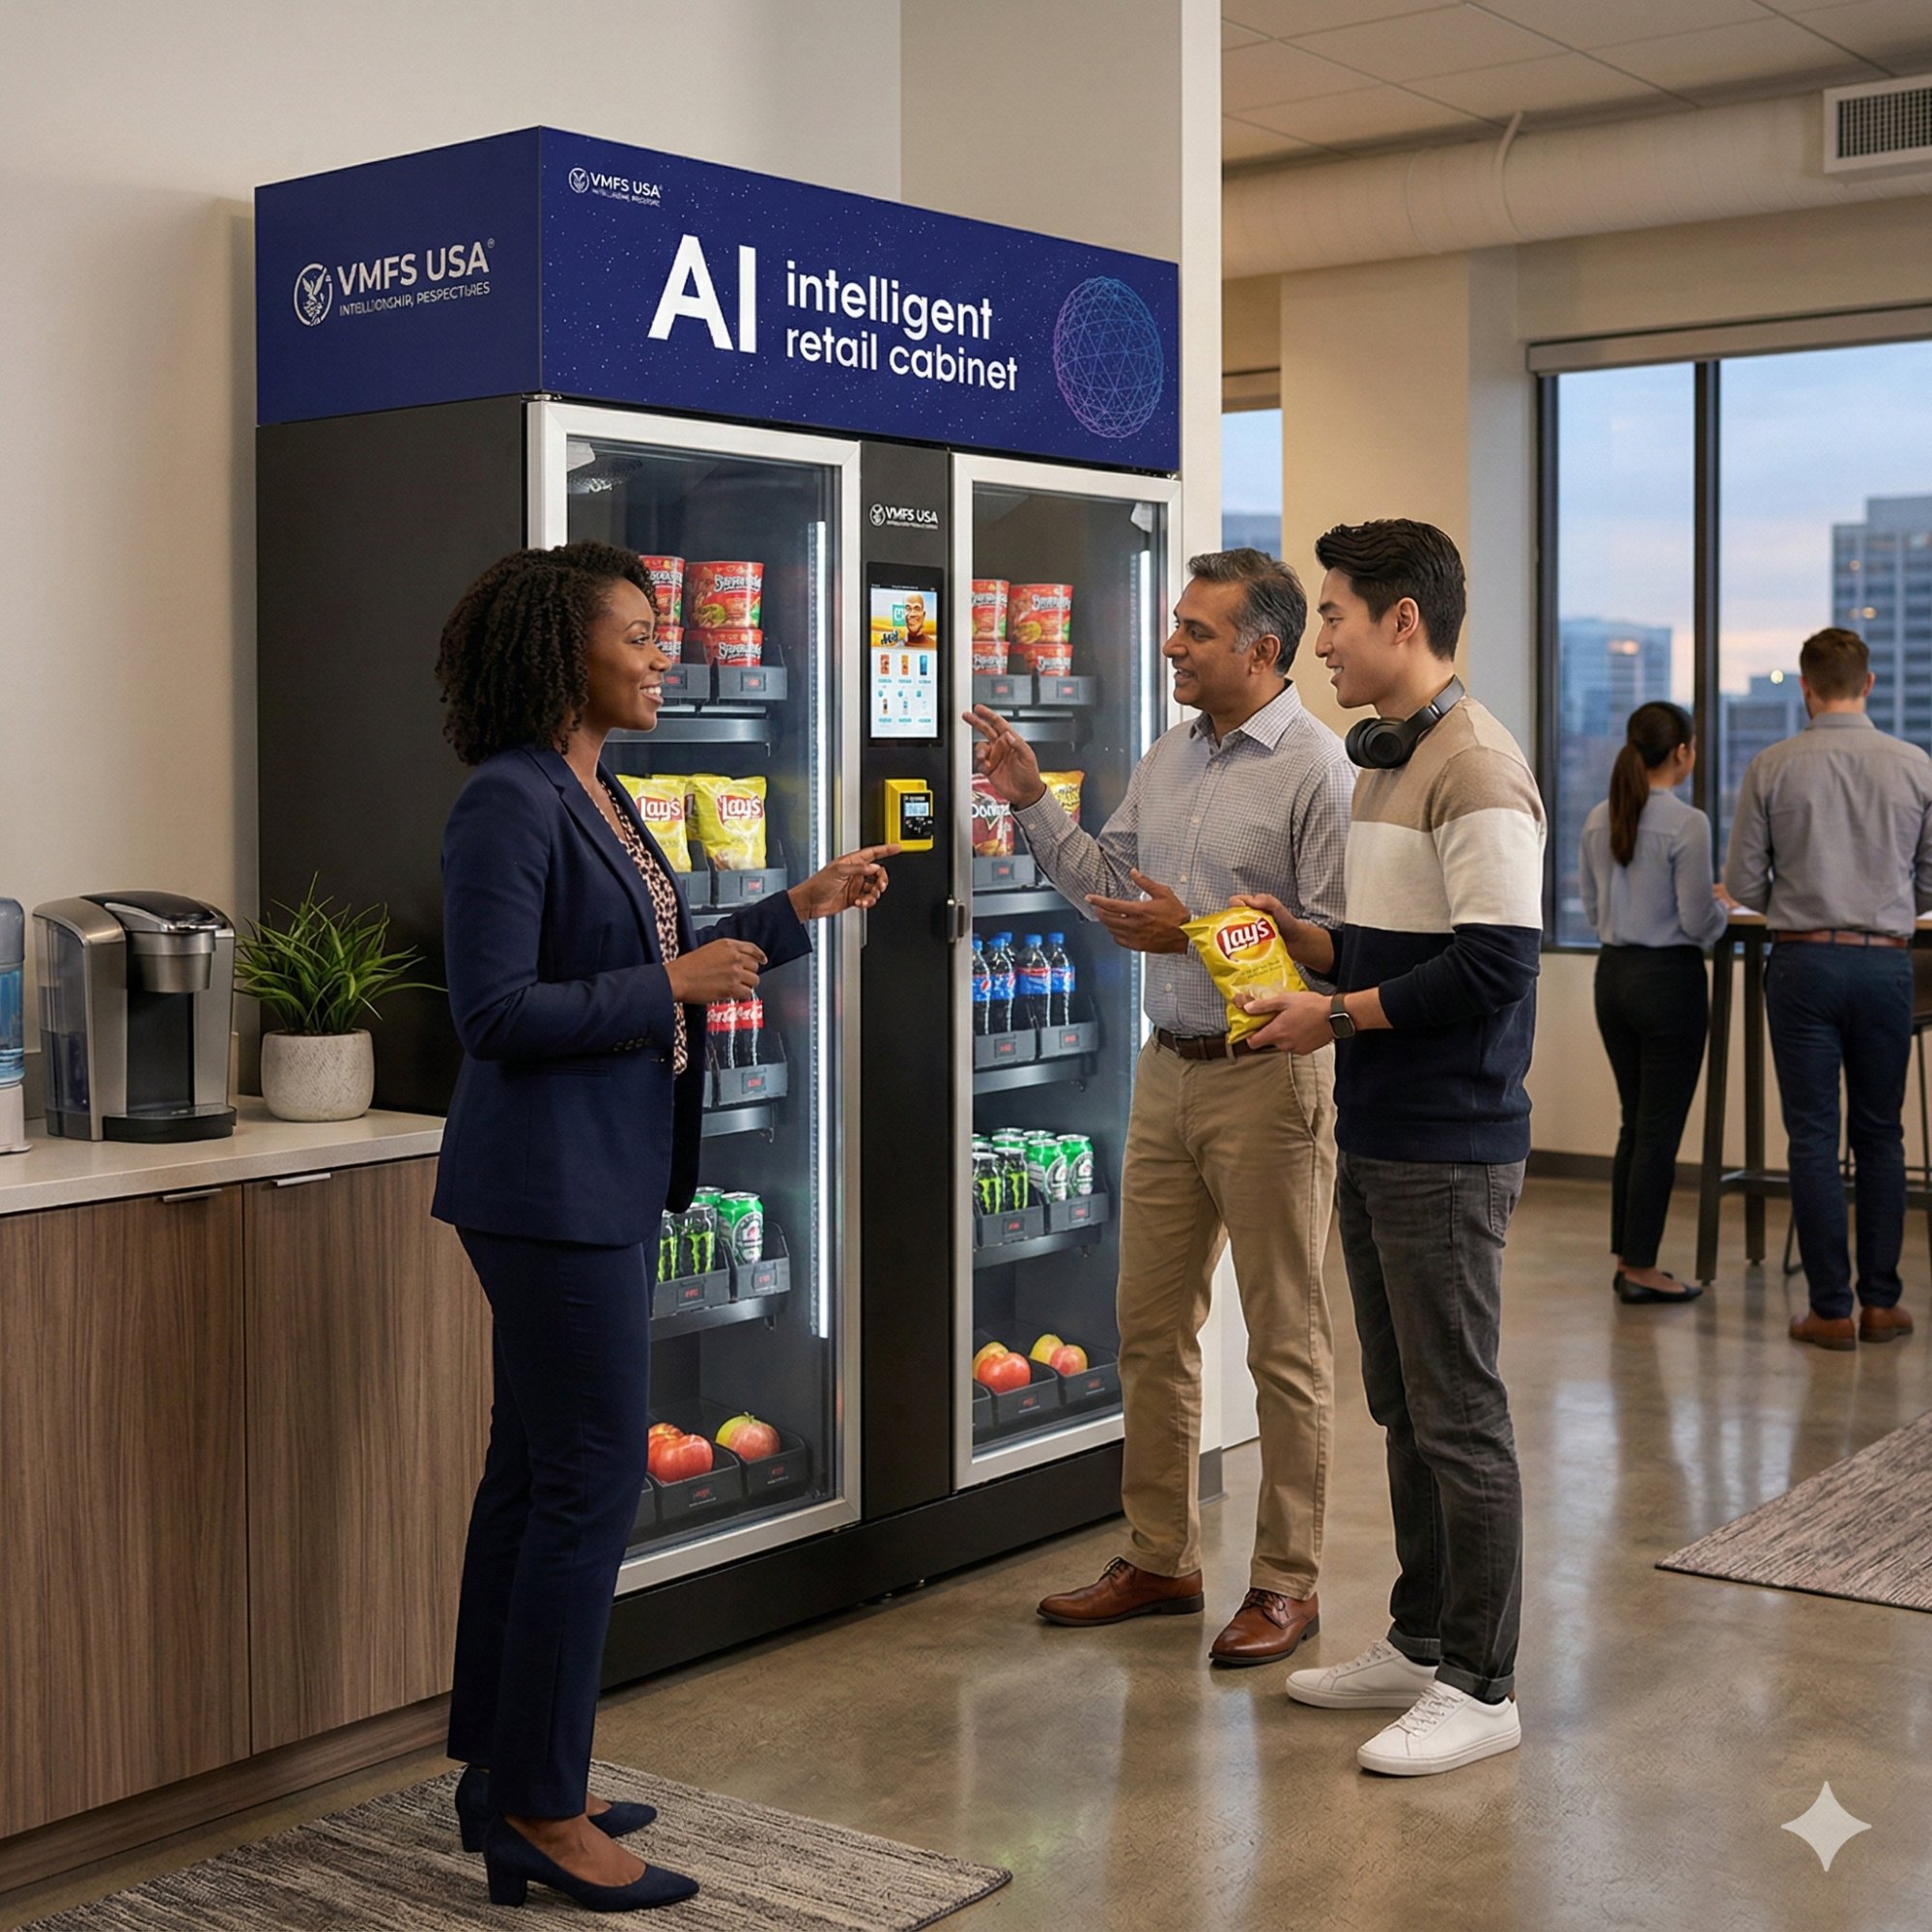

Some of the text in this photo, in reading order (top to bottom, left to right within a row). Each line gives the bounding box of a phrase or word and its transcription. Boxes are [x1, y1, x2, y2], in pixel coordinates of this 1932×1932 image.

[590, 172, 630, 192] VMFS
[633, 181, 661, 199] USA
[337, 253, 417, 297] VMFS
[647, 233, 756, 354] AI
[786, 260, 993, 341] intelligent
[785, 327, 1018, 391] retail cabinet
[885, 505, 939, 524] VMFS USA
[1221, 918, 1271, 955] Lay's
